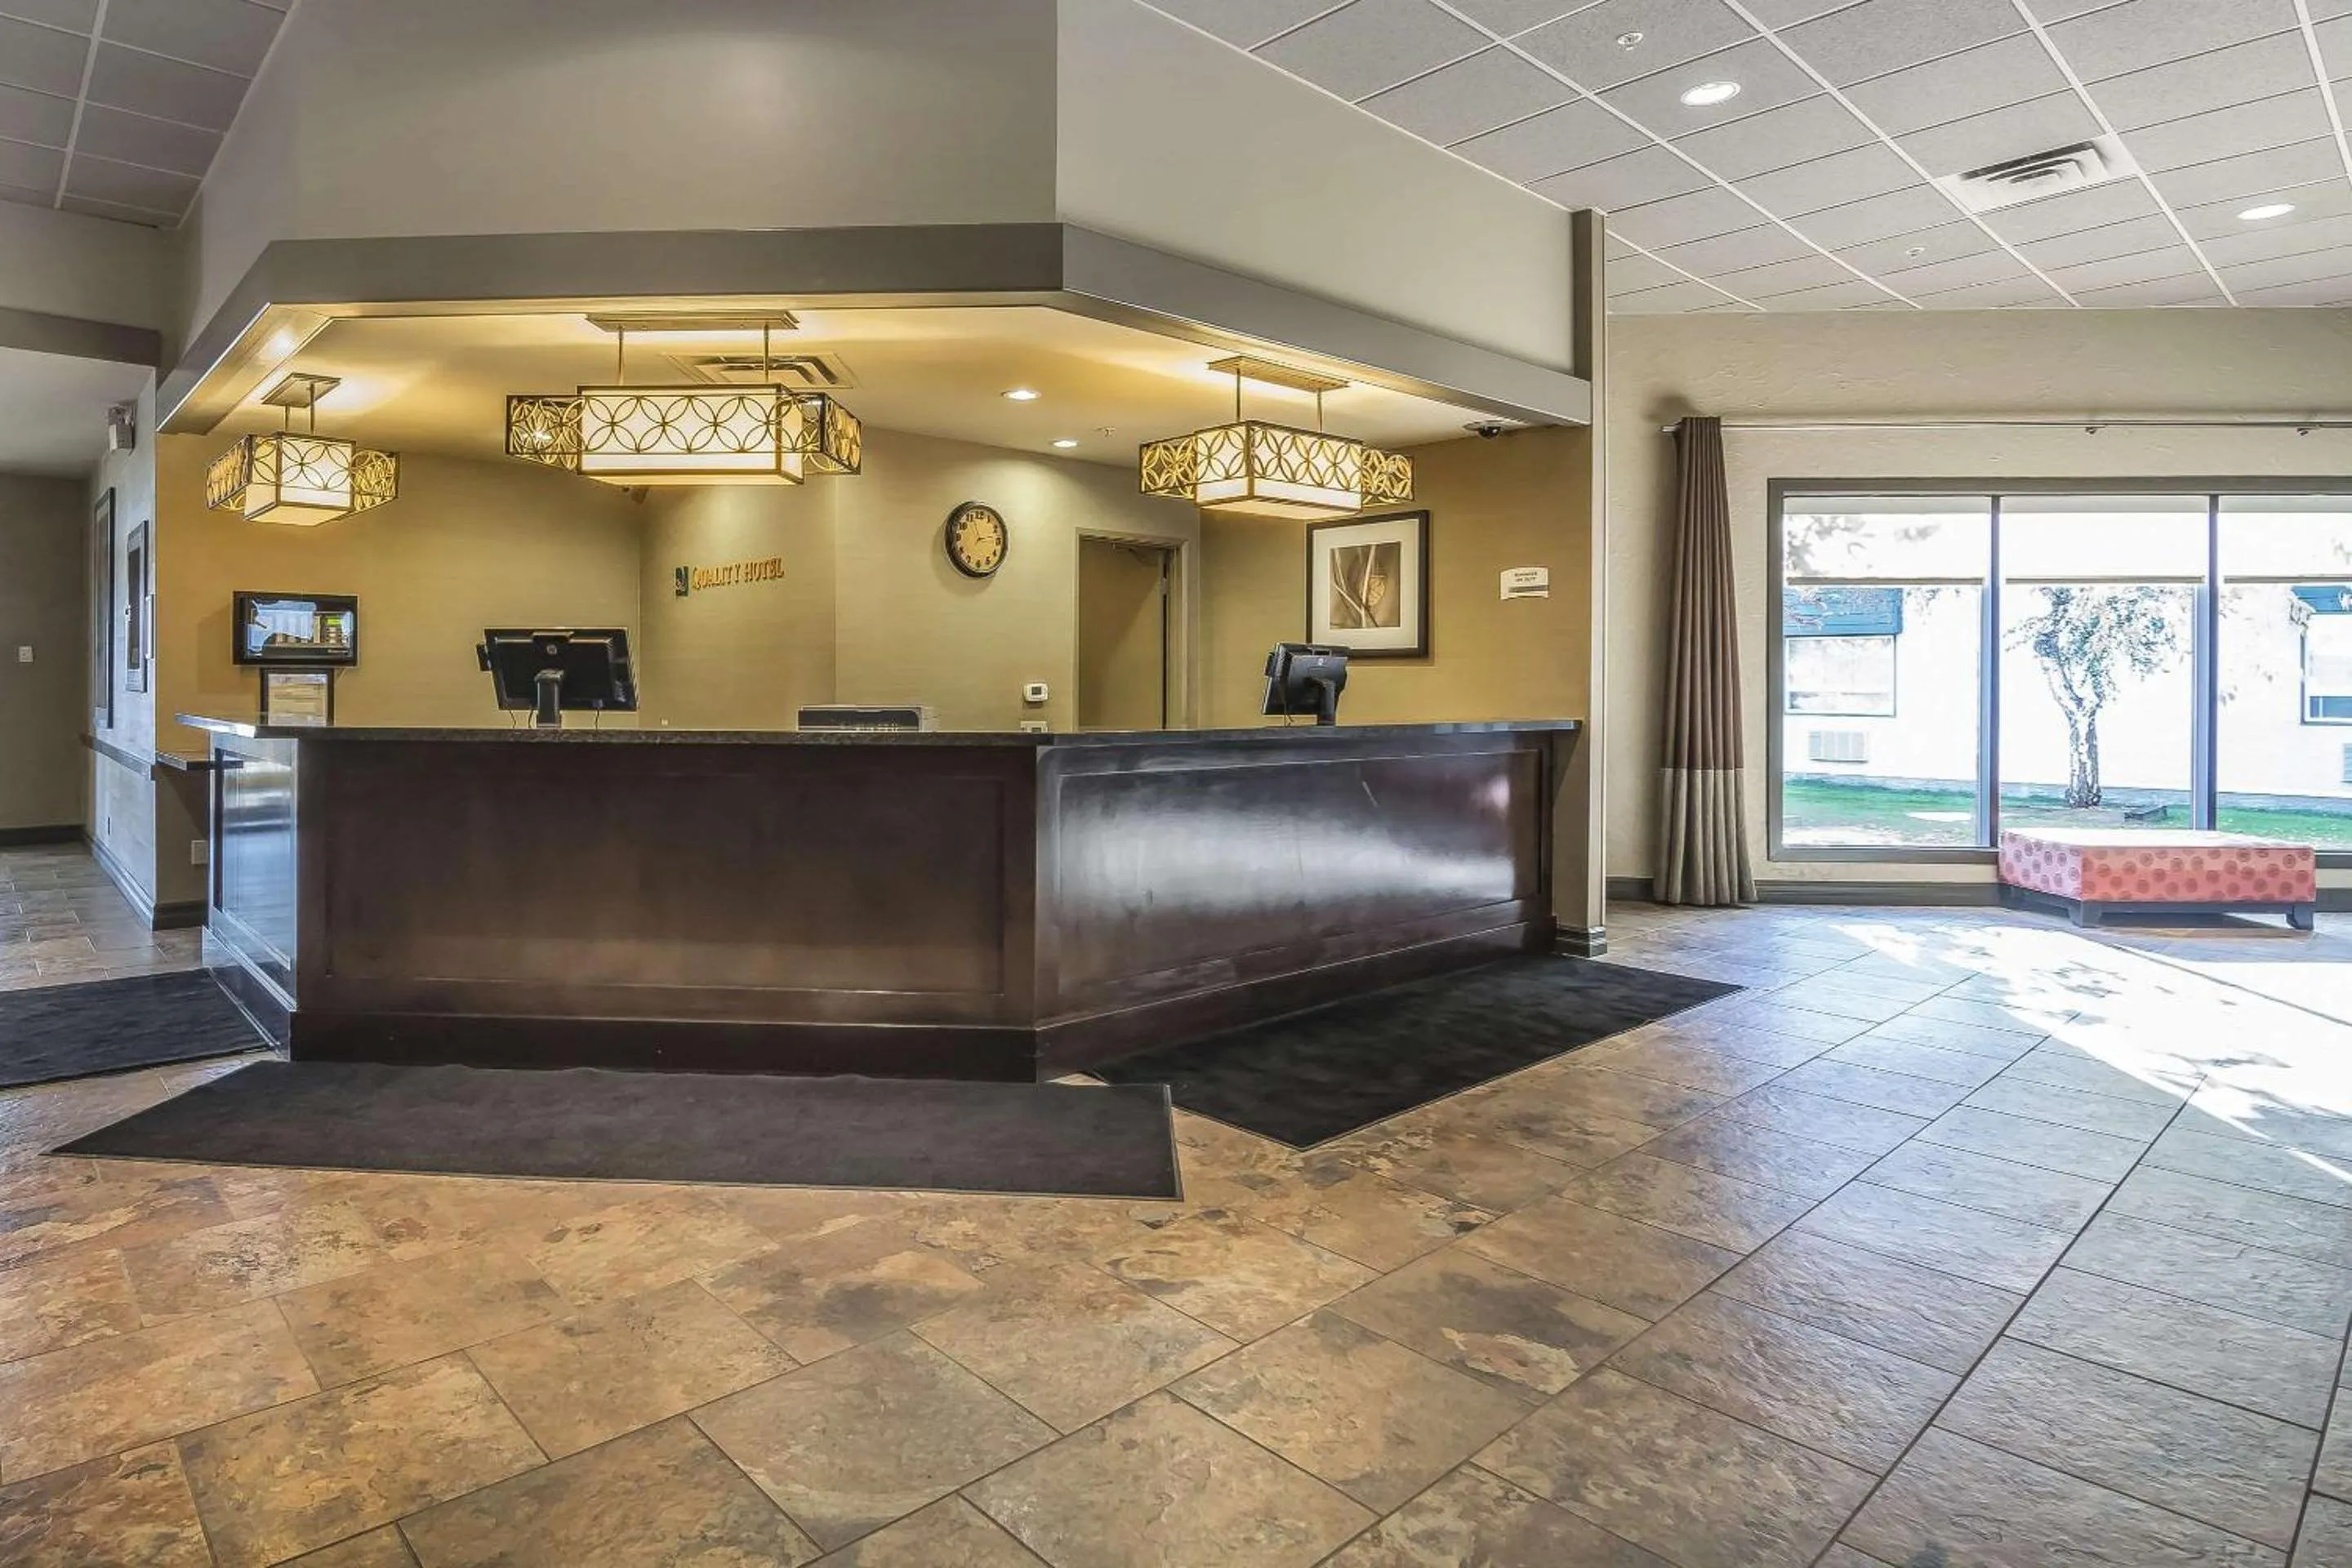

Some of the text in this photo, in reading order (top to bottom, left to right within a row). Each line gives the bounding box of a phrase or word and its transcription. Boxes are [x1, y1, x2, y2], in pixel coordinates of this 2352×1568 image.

[966, 513, 973, 522] 11
[975, 510, 984, 519] 12
[958, 522, 968, 531] 10
[986, 556, 991, 564] 5
[693, 558, 785, 590] QUALITY HOTEL
